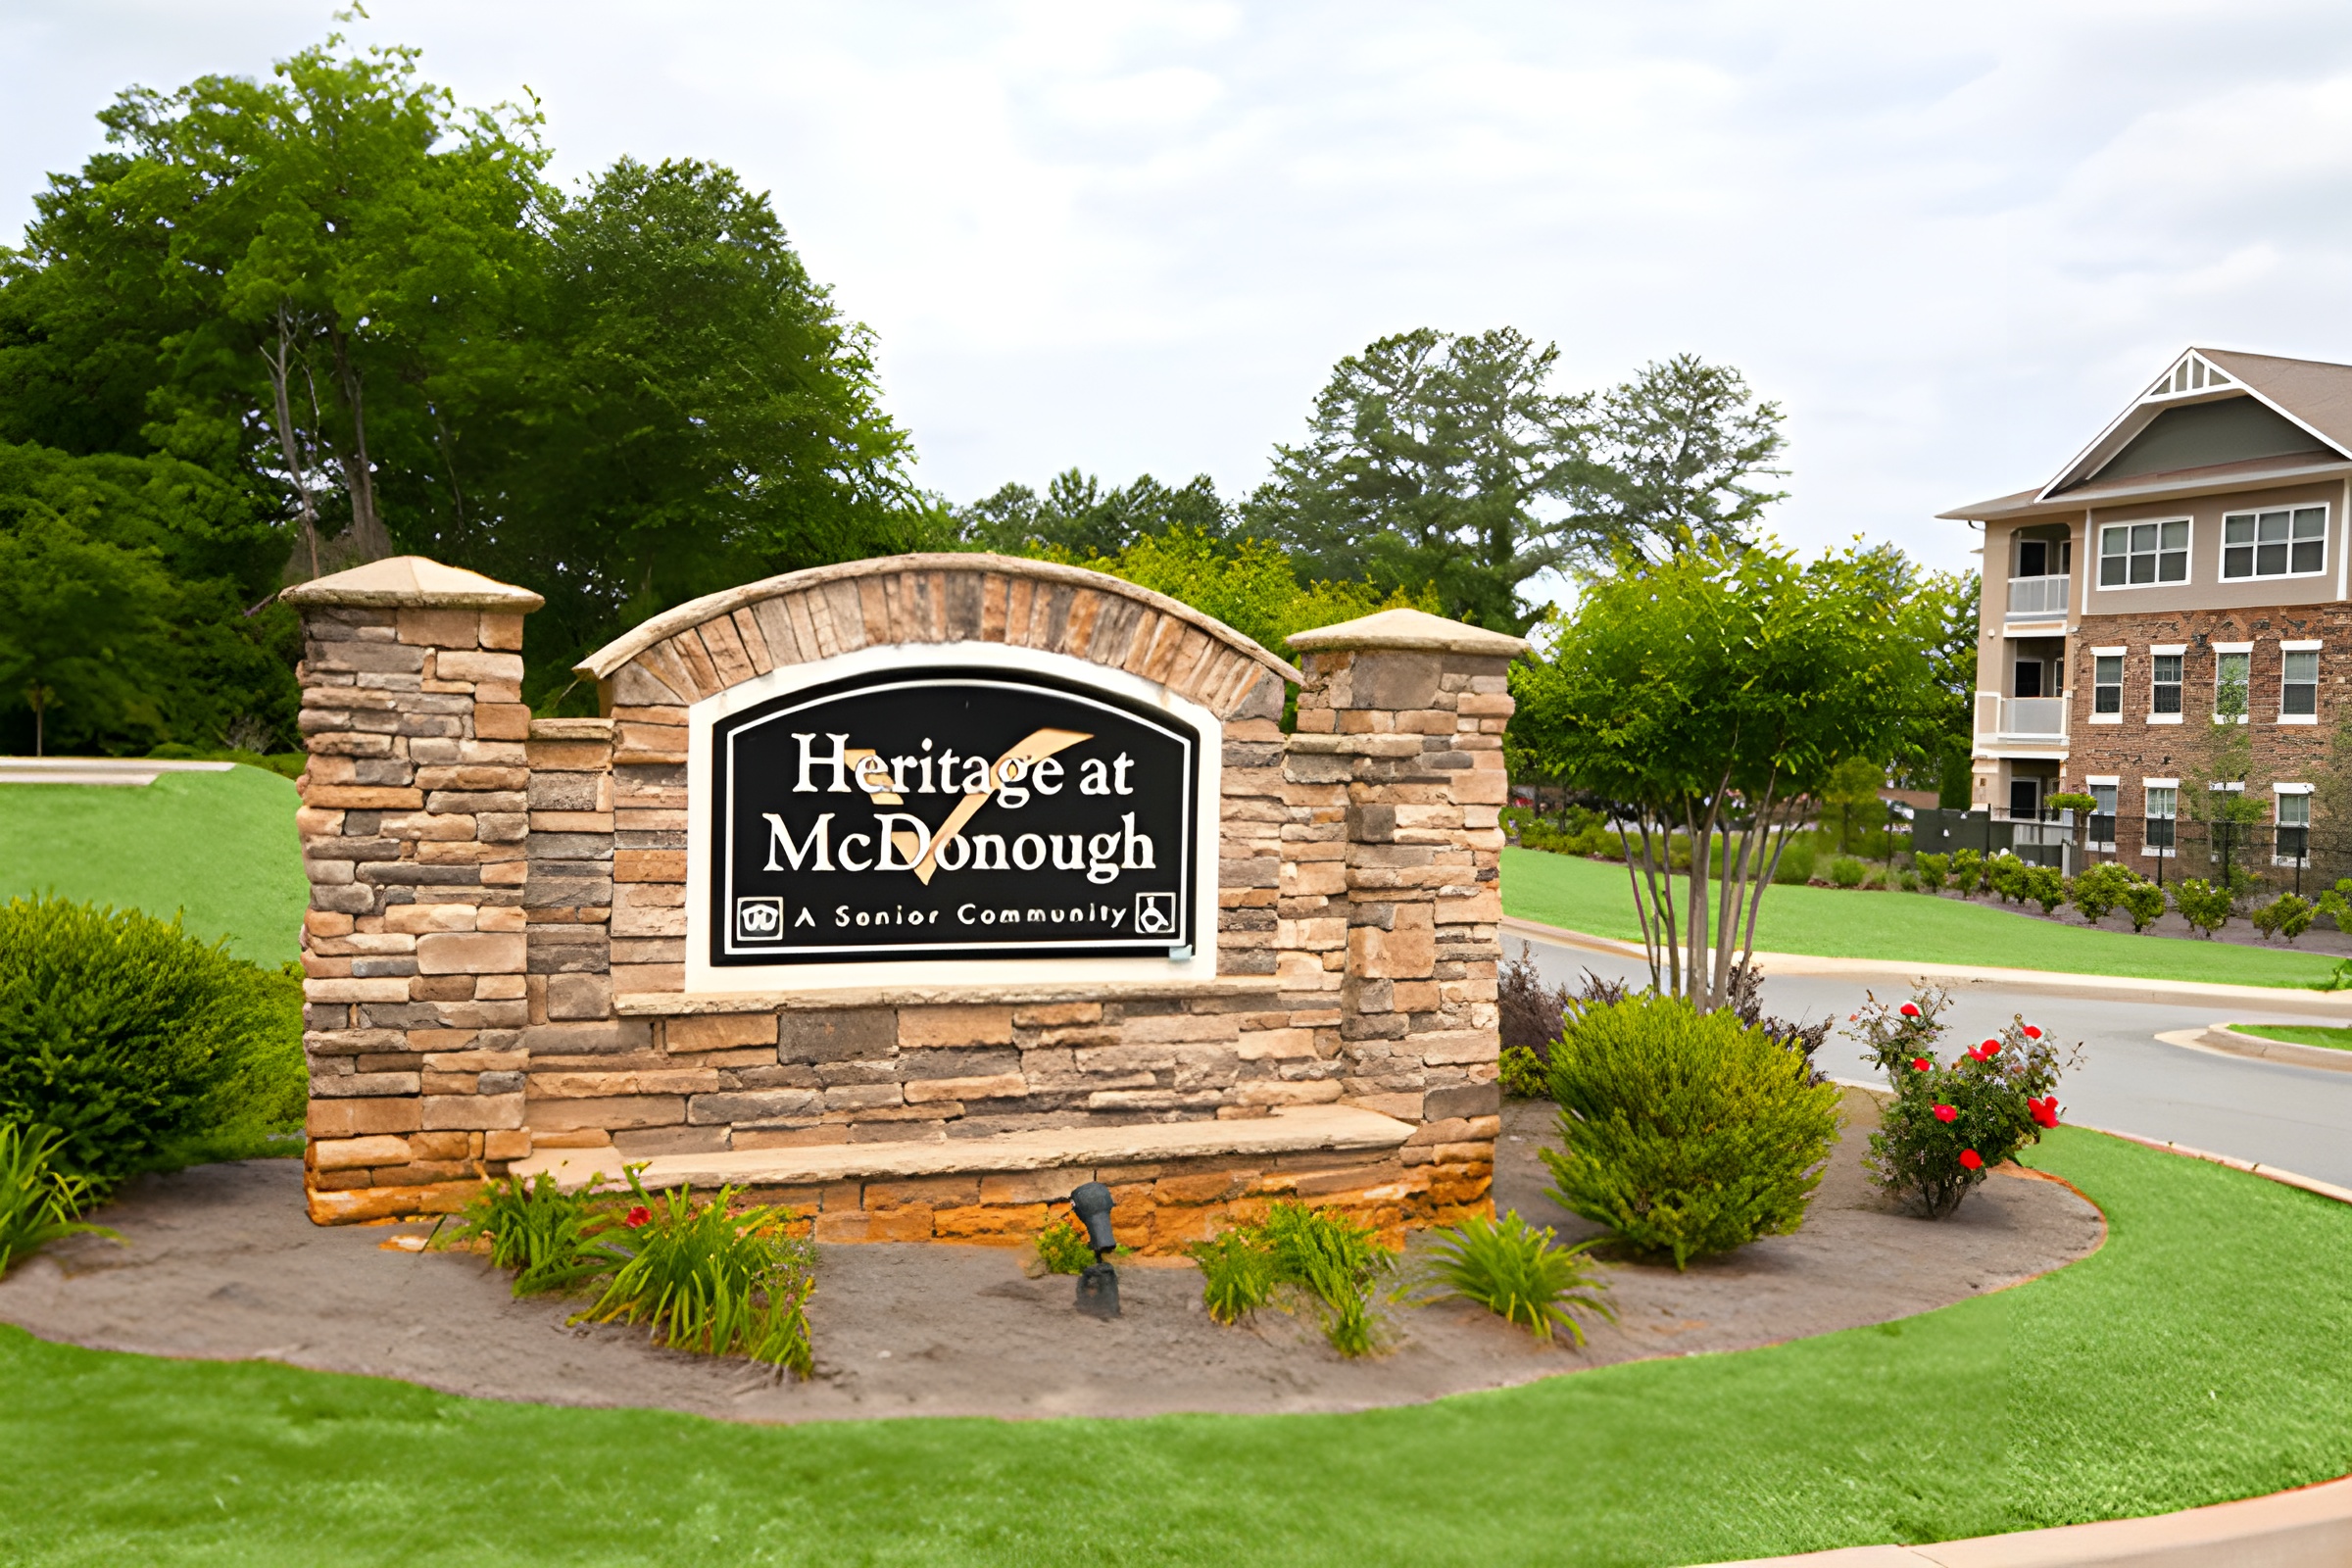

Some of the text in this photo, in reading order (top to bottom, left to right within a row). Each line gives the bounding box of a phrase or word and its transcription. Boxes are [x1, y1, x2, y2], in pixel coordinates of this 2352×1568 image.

[791, 732, 1135, 808] Heritage at
[762, 811, 1156, 884] McDonough
[795, 906, 816, 927] A
